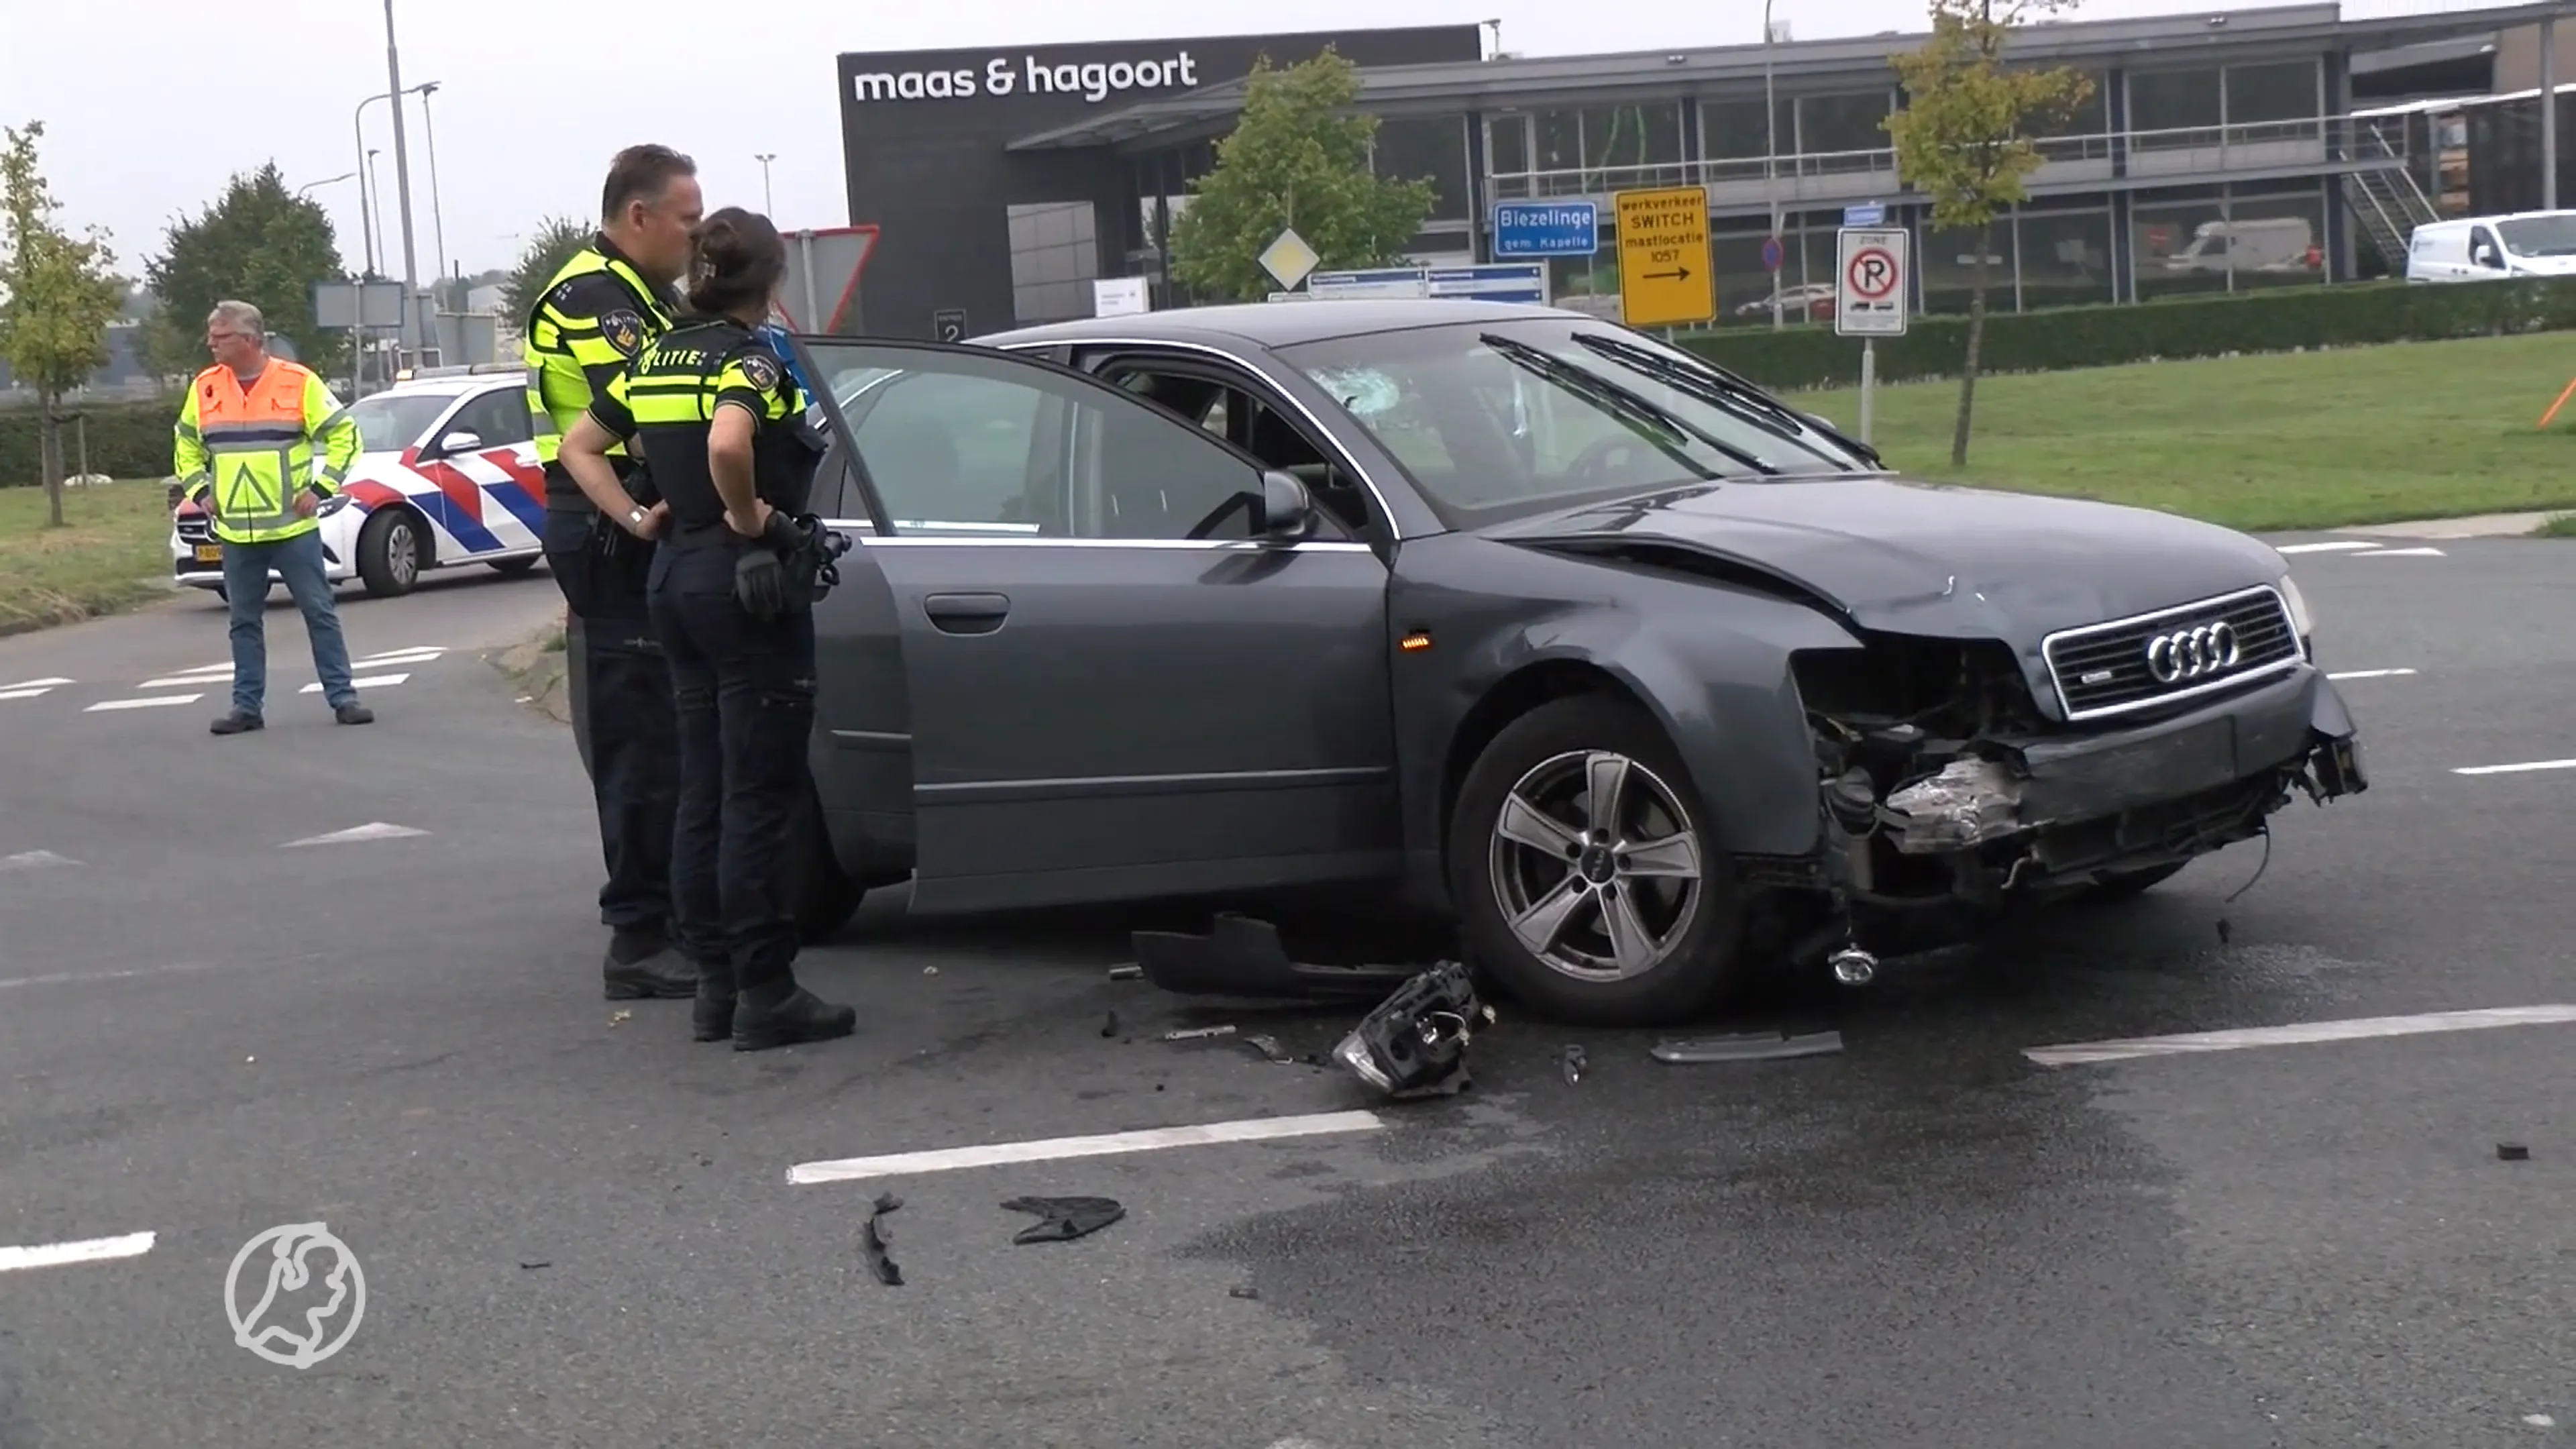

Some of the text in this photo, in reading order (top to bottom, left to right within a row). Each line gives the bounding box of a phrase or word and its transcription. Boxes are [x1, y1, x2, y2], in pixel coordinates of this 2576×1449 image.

[854, 51, 1198, 103] maas & hagoort
[1621, 196, 1702, 211] werkverkeer
[1500, 209, 1591, 229] Biezelinge
[1631, 211, 1695, 229] SWITCH
[1540, 236, 1588, 249] Kapelle
[1625, 232, 1703, 248] mastlocatie
[1650, 249, 1680, 263] 1057
